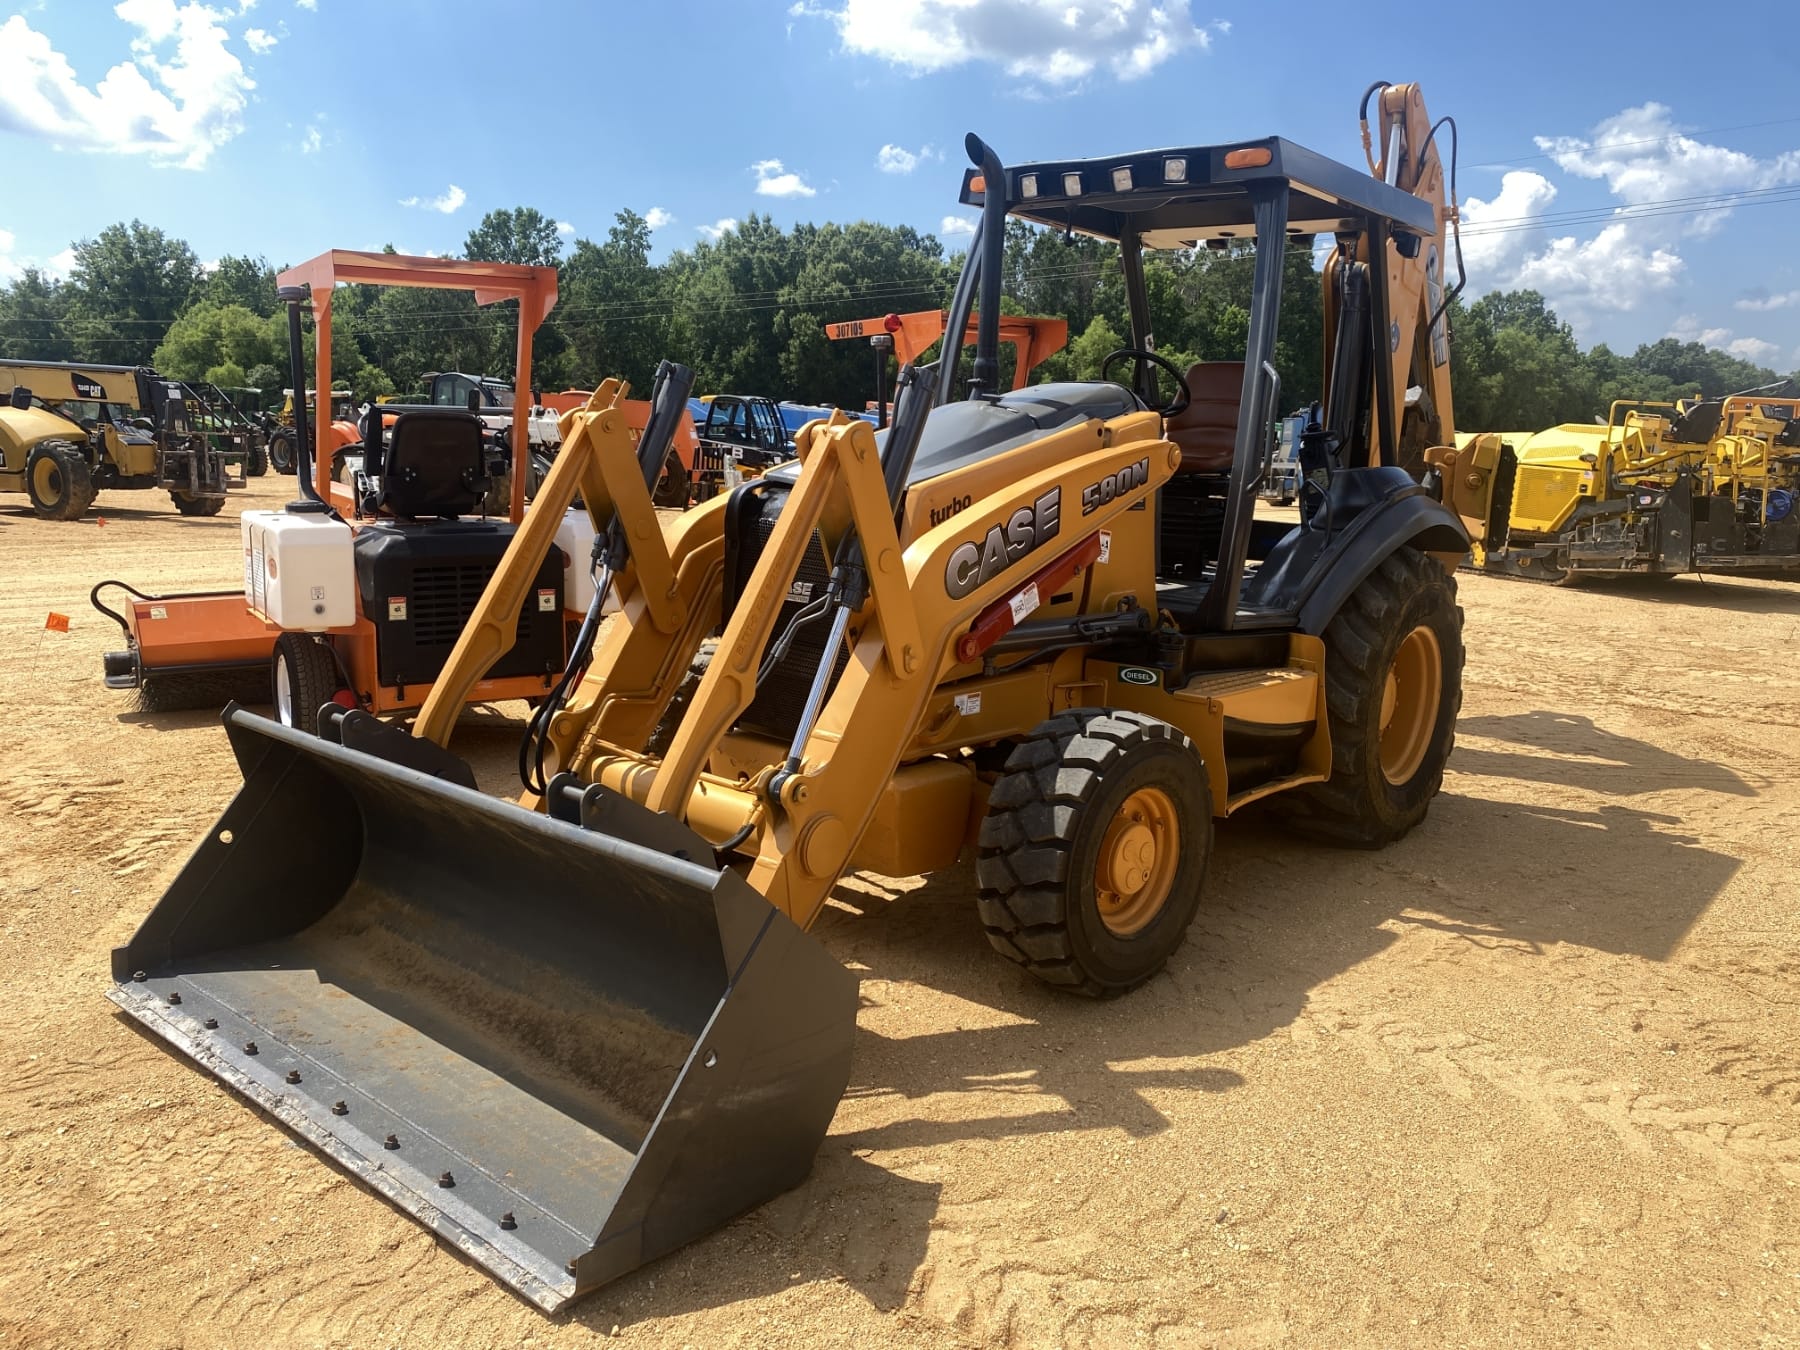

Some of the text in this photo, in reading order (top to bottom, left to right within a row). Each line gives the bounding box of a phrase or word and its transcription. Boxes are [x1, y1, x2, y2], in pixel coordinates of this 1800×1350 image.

[836, 322, 864, 338] 307109
[90, 385, 101, 397] CAT
[1082, 457, 1149, 517] 580N
[930, 494, 972, 528] turbo
[944, 485, 1061, 600] CASE
[787, 581, 813, 597] SE
[1126, 671, 1151, 681] DIESEL
